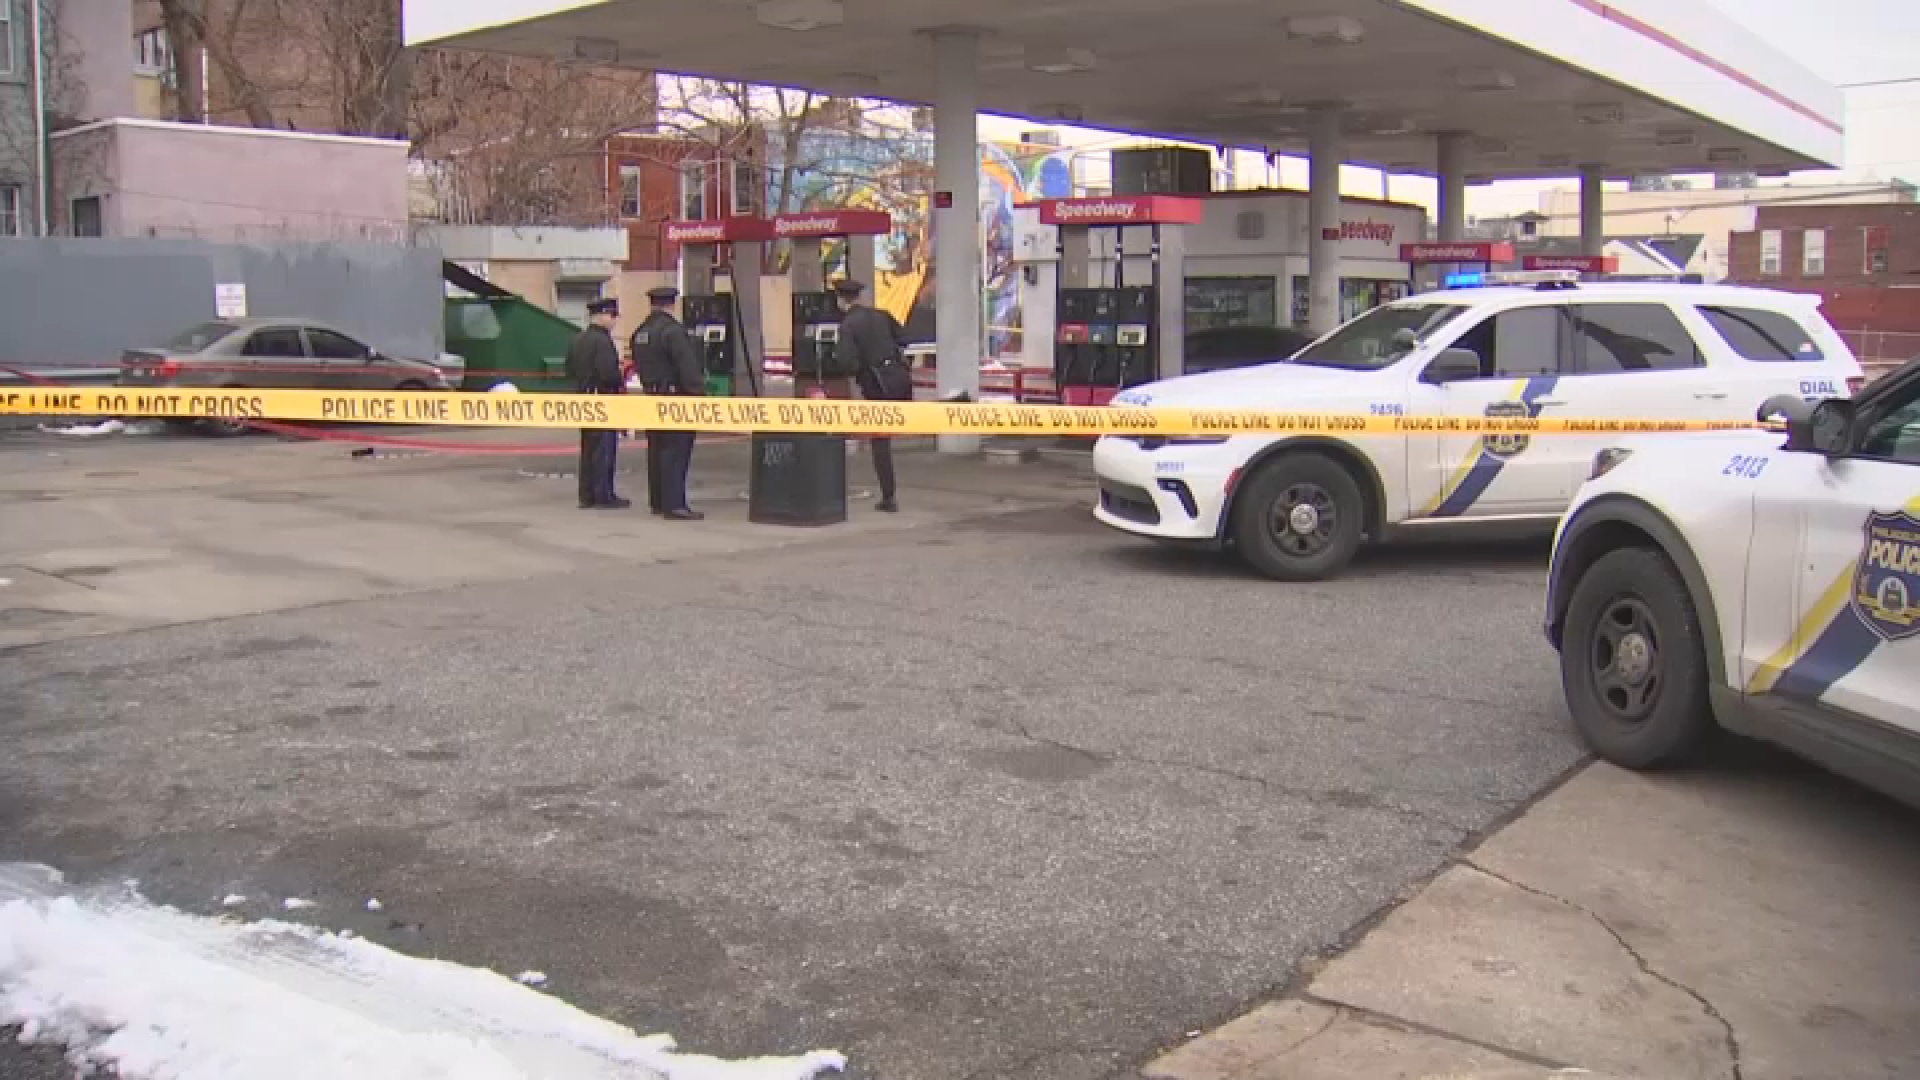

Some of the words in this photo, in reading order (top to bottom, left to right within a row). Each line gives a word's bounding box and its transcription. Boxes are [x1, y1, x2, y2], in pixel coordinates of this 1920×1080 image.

[1054, 200, 1137, 220] Speedway
[667, 224, 724, 242] Speedway
[775, 216, 838, 235] Speedway
[1799, 381, 1838, 395] DIAL
[136, 395, 182, 413] NOT
[188, 395, 262, 418] CROSS
[321, 397, 396, 420] POLICE
[402, 397, 449, 421] LINE
[460, 399, 489, 421] DO
[495, 399, 535, 421] NOT
[541, 400, 609, 423] CROSS
[656, 401, 725, 424] POLICE
[727, 403, 771, 425] LINE
[778, 403, 804, 426] DO
[807, 404, 843, 426] NOT
[847, 404, 907, 427] CROSS
[944, 406, 1004, 428] POLICE
[1004, 408, 1044, 428] LINE
[1047, 409, 1073, 429] DO
[1073, 409, 1105, 429] NOT
[1106, 409, 1158, 430] CROSS
[1721, 454, 1769, 479] 2413
